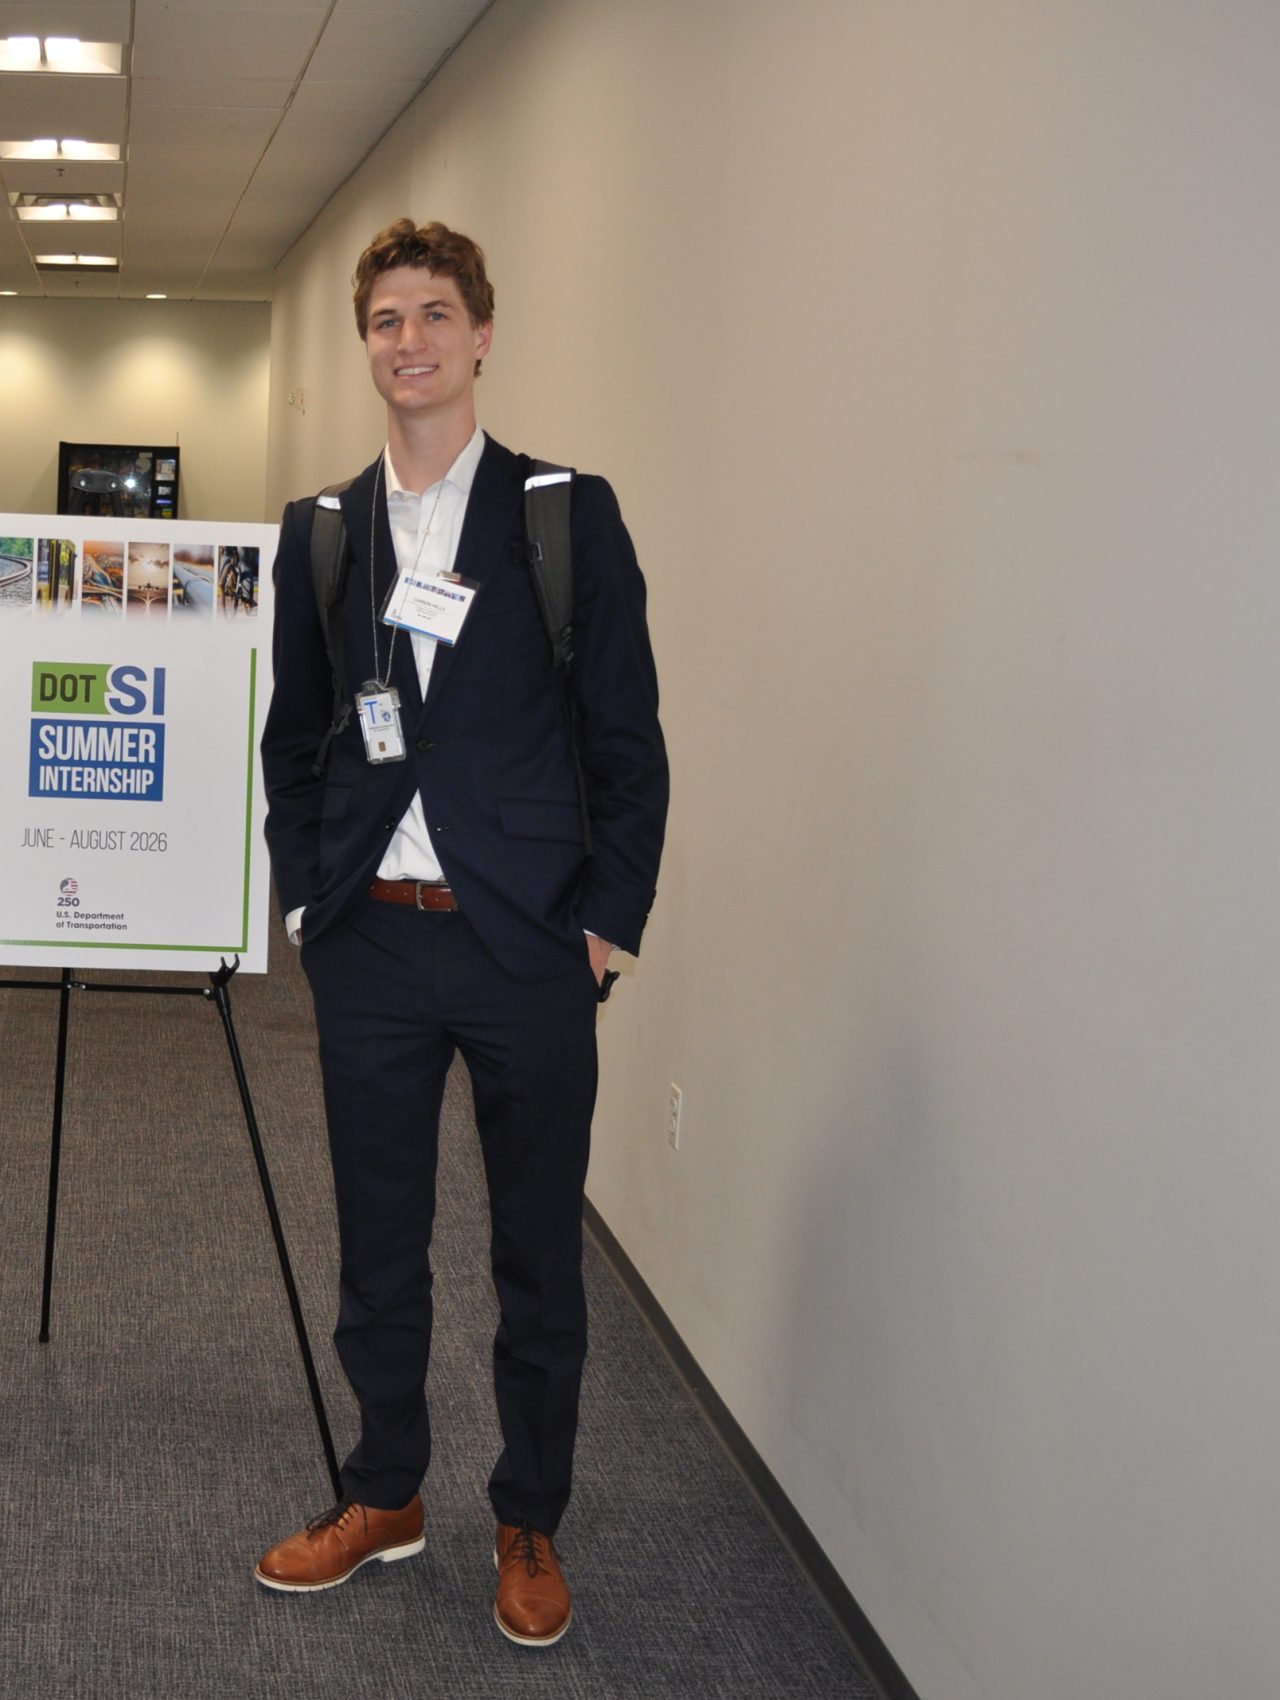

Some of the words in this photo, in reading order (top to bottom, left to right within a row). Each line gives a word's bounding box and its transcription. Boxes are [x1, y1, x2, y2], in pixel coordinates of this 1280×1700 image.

[39, 672, 97, 703] DOT
[108, 665, 166, 716] SI
[38, 724, 157, 764] SUMMER
[39, 765, 155, 795] INTERNSHIP
[20, 827, 55, 849] JUNE
[69, 829, 127, 851] AUGUST
[130, 831, 168, 852] 2026
[57, 897, 80, 907] 250
[56, 911, 72, 919] U.S.
[74, 911, 124, 920] Department
[66, 921, 128, 931] Transportation
